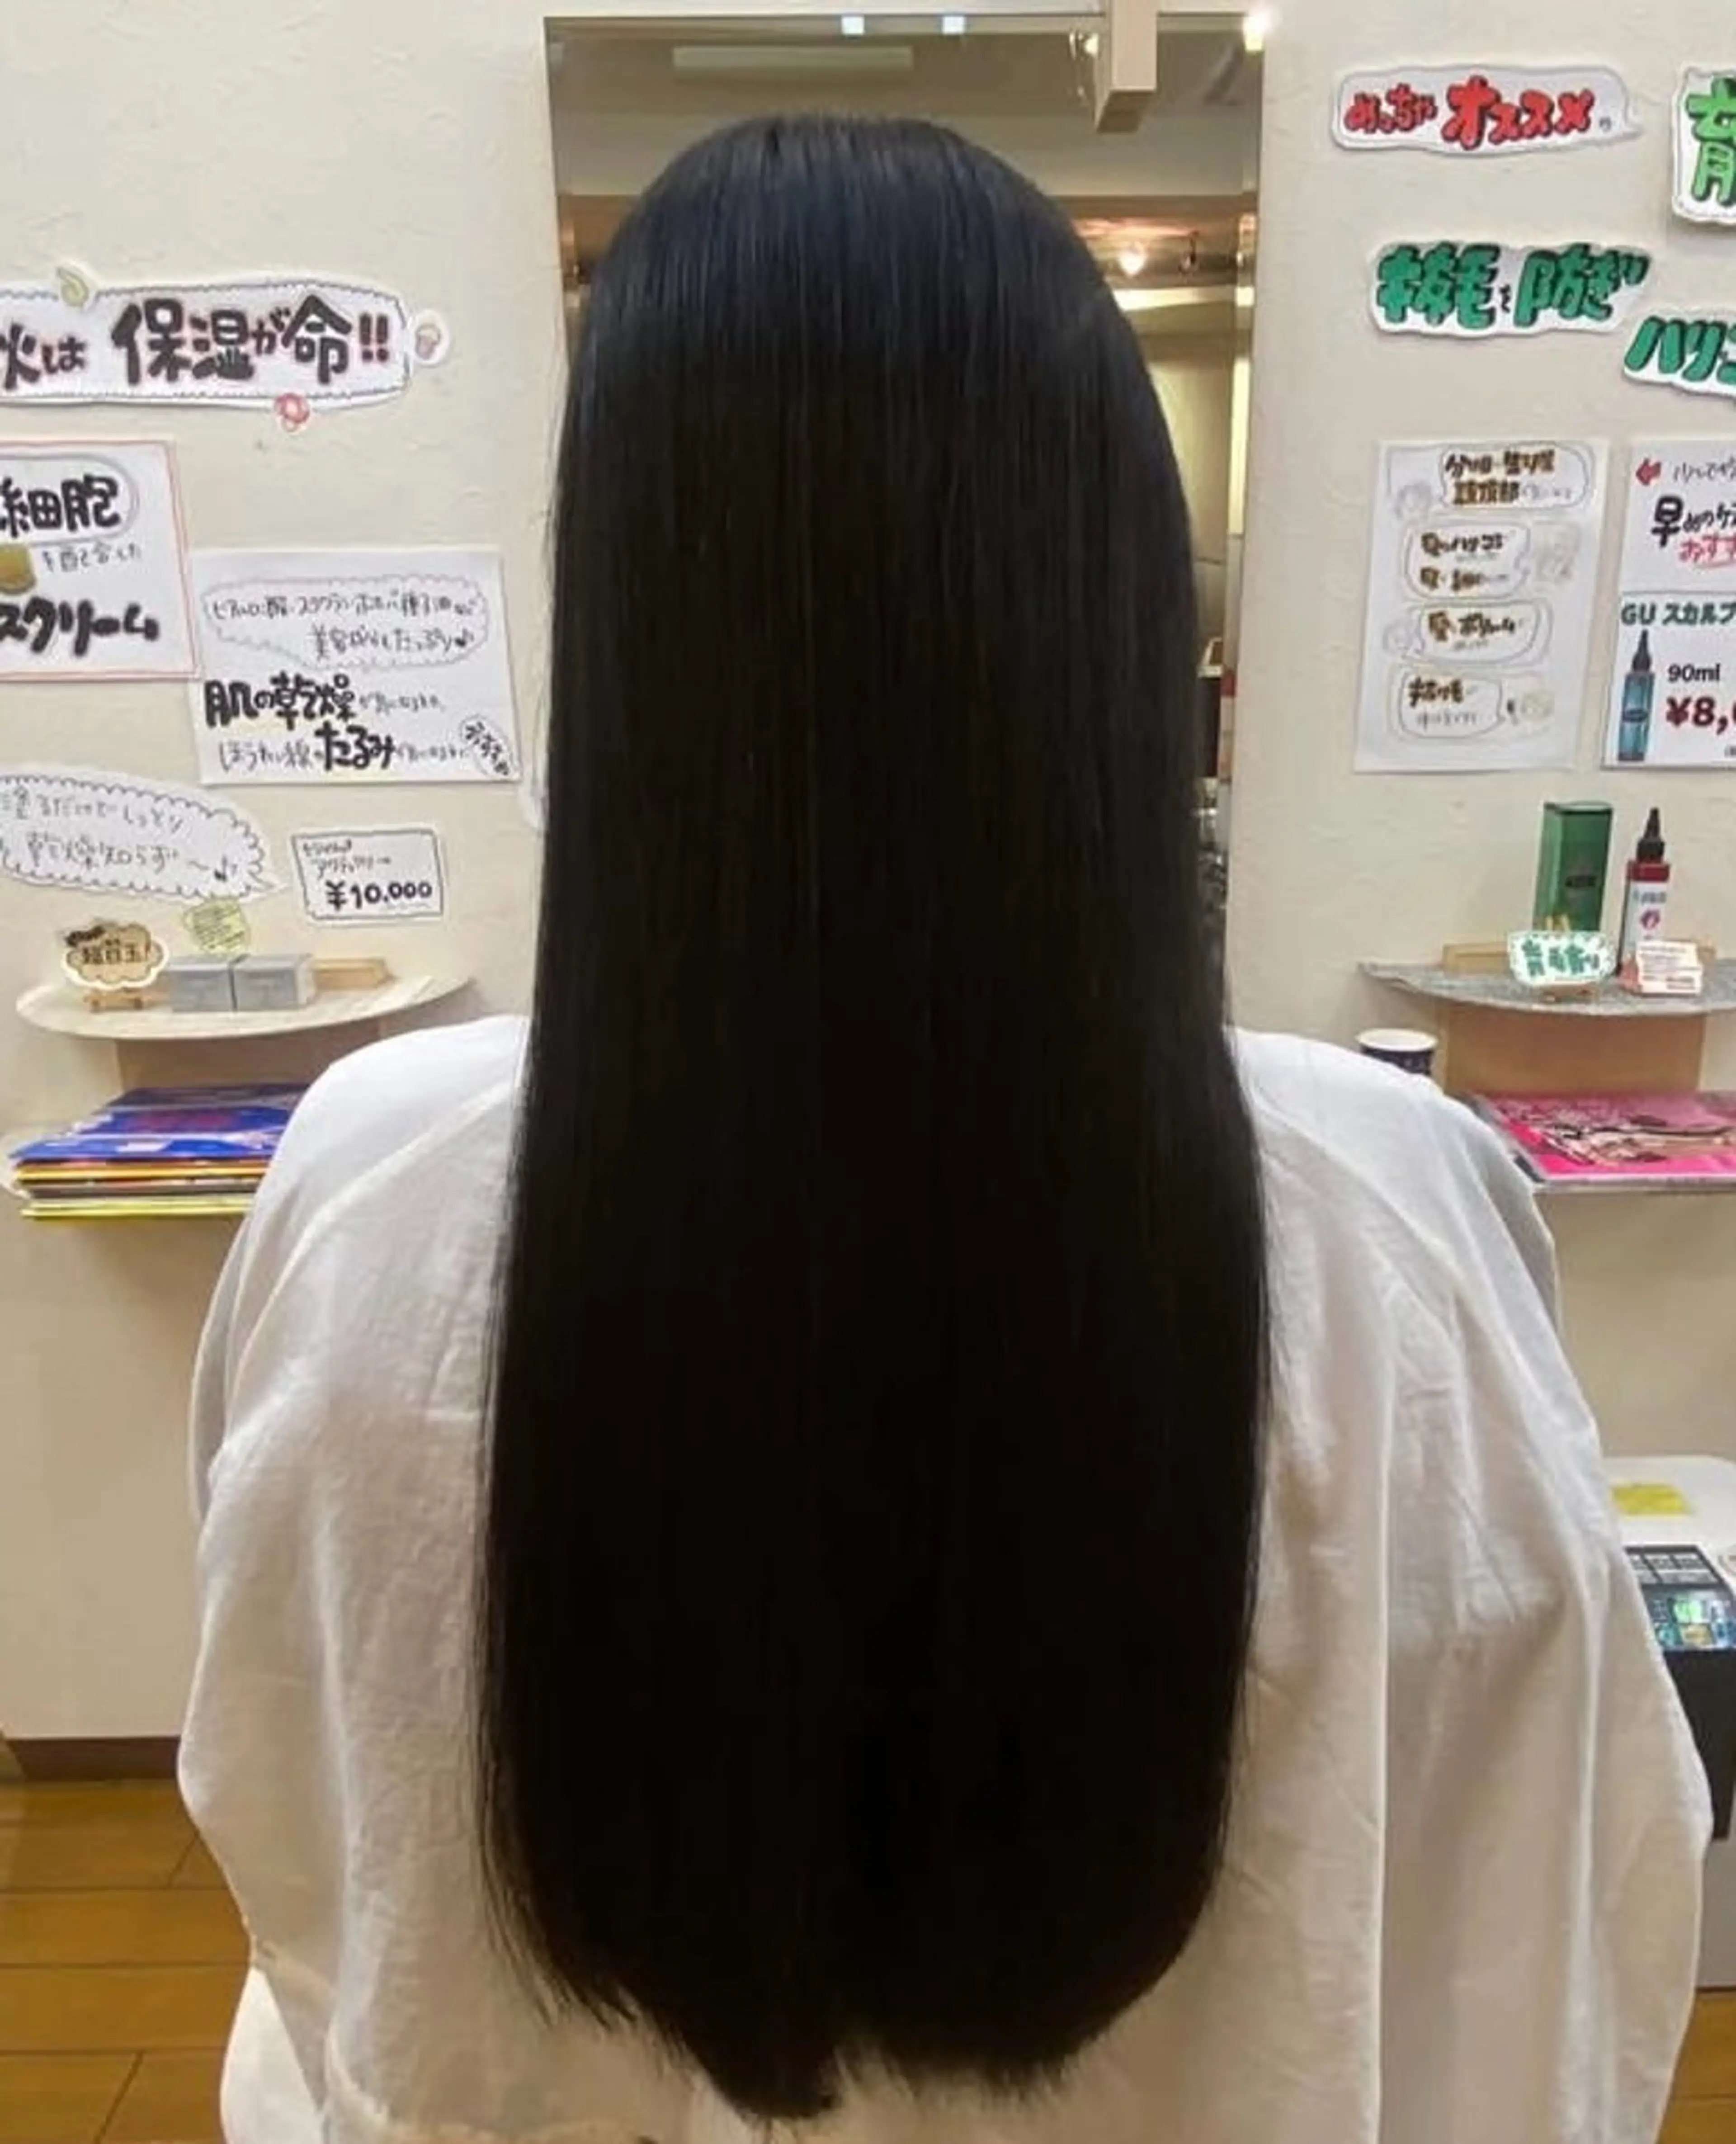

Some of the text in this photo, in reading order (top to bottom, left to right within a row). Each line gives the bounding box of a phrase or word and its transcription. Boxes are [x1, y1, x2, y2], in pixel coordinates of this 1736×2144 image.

[1651, 496, 1736, 548] 早めのケ
[1621, 602, 1656, 626] GU
[1665, 696, 1736, 735] ¥8,
